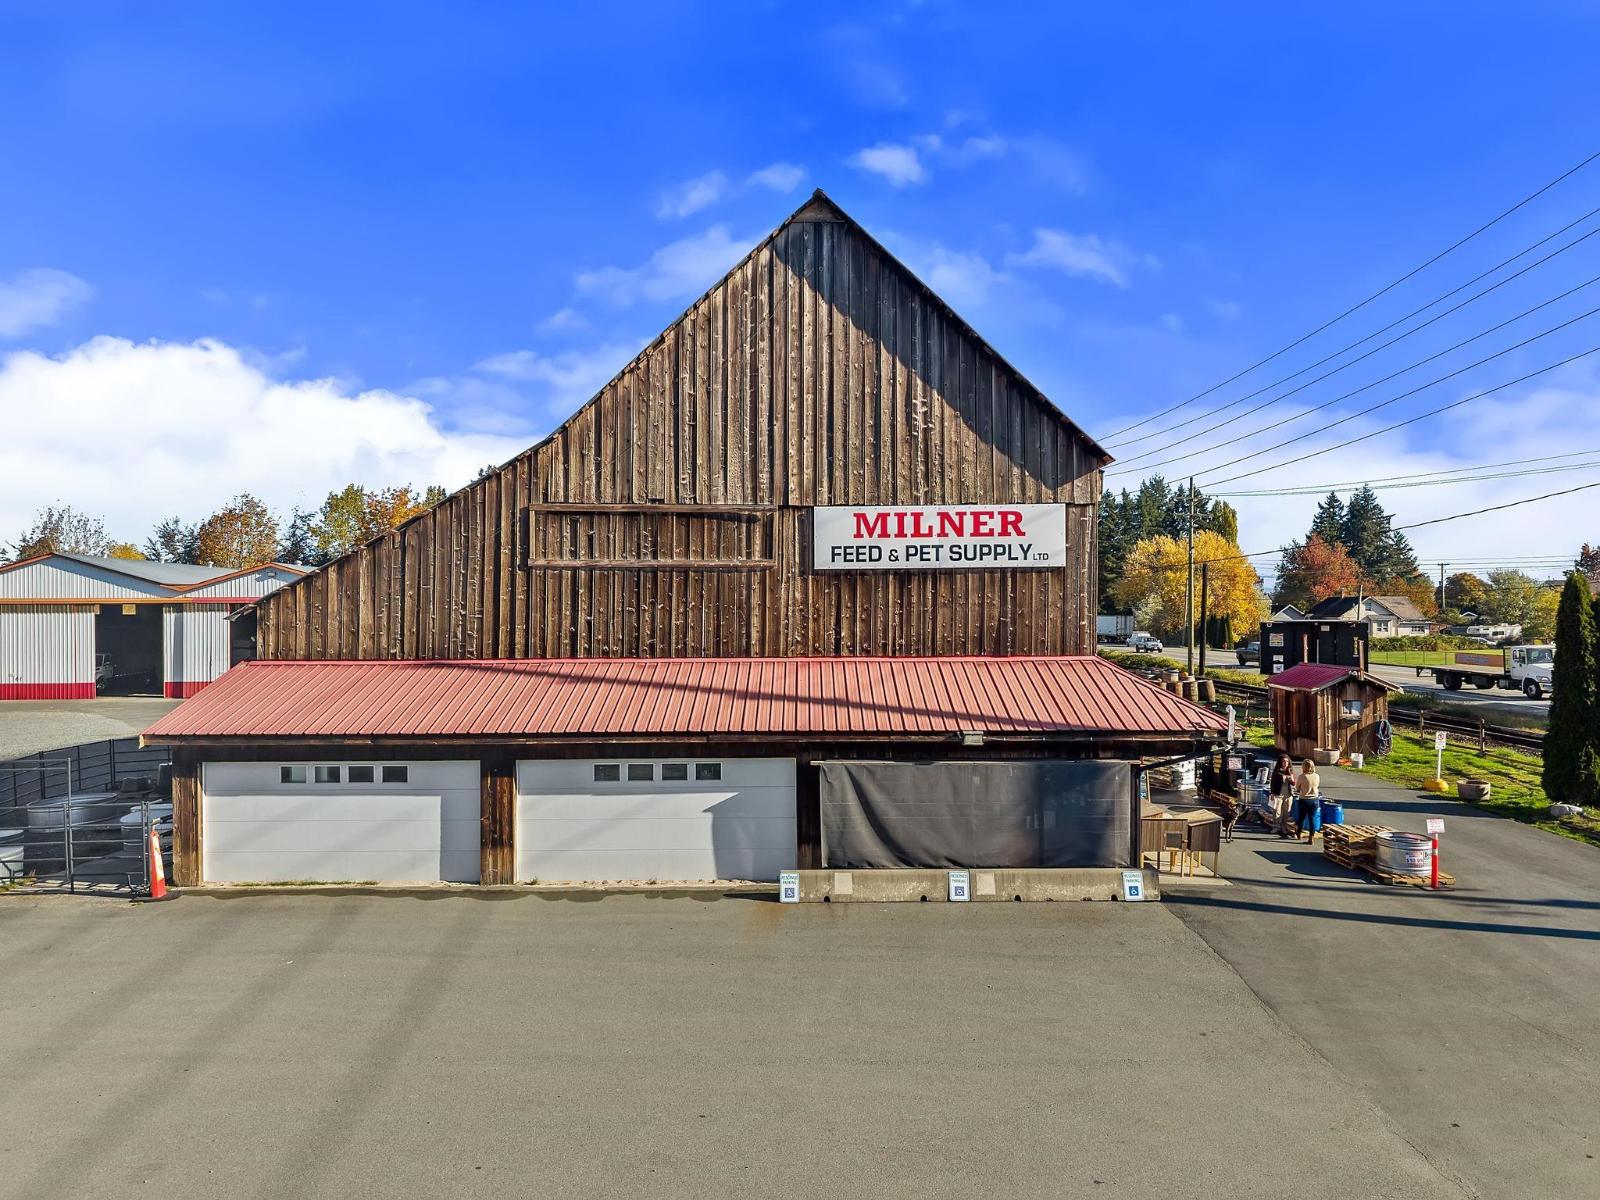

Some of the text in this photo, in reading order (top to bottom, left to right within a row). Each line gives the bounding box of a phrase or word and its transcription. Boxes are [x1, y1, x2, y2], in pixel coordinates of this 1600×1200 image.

[853, 511, 1026, 539] MILNER
[831, 543, 1049, 563] FEED & PET SUPPLY LTD
